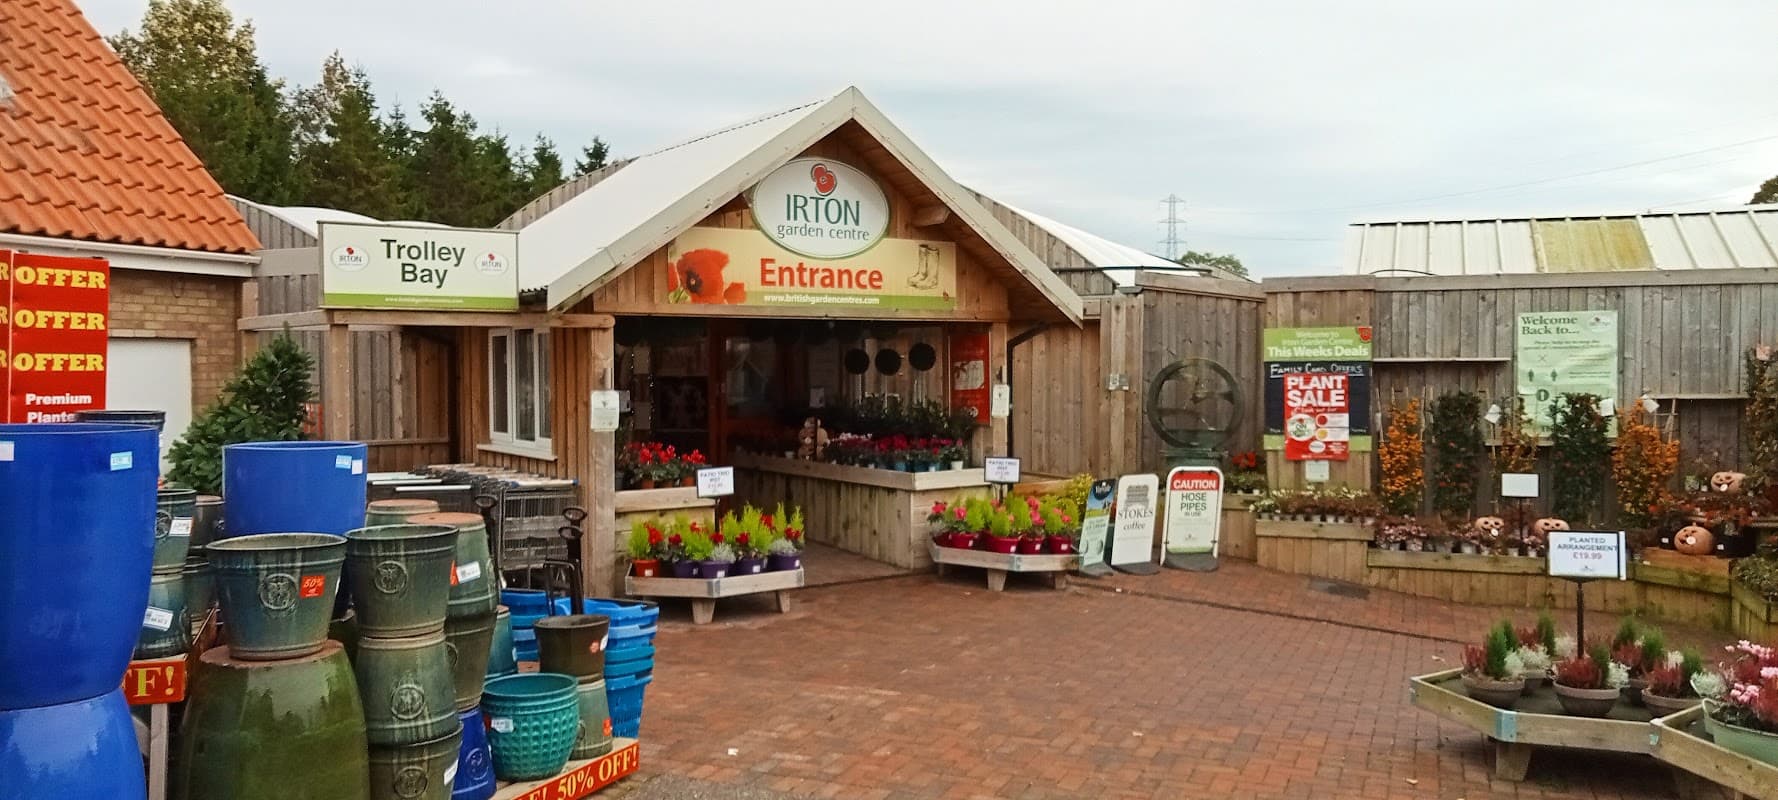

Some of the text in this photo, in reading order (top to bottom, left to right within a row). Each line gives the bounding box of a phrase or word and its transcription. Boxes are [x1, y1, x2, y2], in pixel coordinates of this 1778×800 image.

[786, 194, 860, 227] IRTON
[777, 223, 870, 241] garden centre
[380, 239, 466, 267] Trolley
[15, 266, 107, 289] OFFER
[401, 263, 448, 289] Bay
[760, 258, 883, 290] Entrance
[14, 309, 106, 331] OFFER
[1521, 316, 1578, 325] Welcome
[1522, 326, 1552, 335] Back
[1267, 345, 1369, 357] This Weeks Deals
[13, 353, 105, 372] OFFER
[1287, 375, 1346, 389] PLANT
[25, 392, 92, 405] Premium
[1287, 389, 1346, 407] SALE
[27, 411, 78, 423] Plante
[1173, 479, 1216, 489] CAUTION
[1181, 492, 1207, 501] HOSE
[1118, 507, 1153, 519] STOKES
[1180, 502, 1207, 512] PIPES
[1123, 521, 1146, 530] coffee
[1557, 543, 1618, 552] ARRANGEMENT
[557, 745, 638, 800] 50% OFF!
